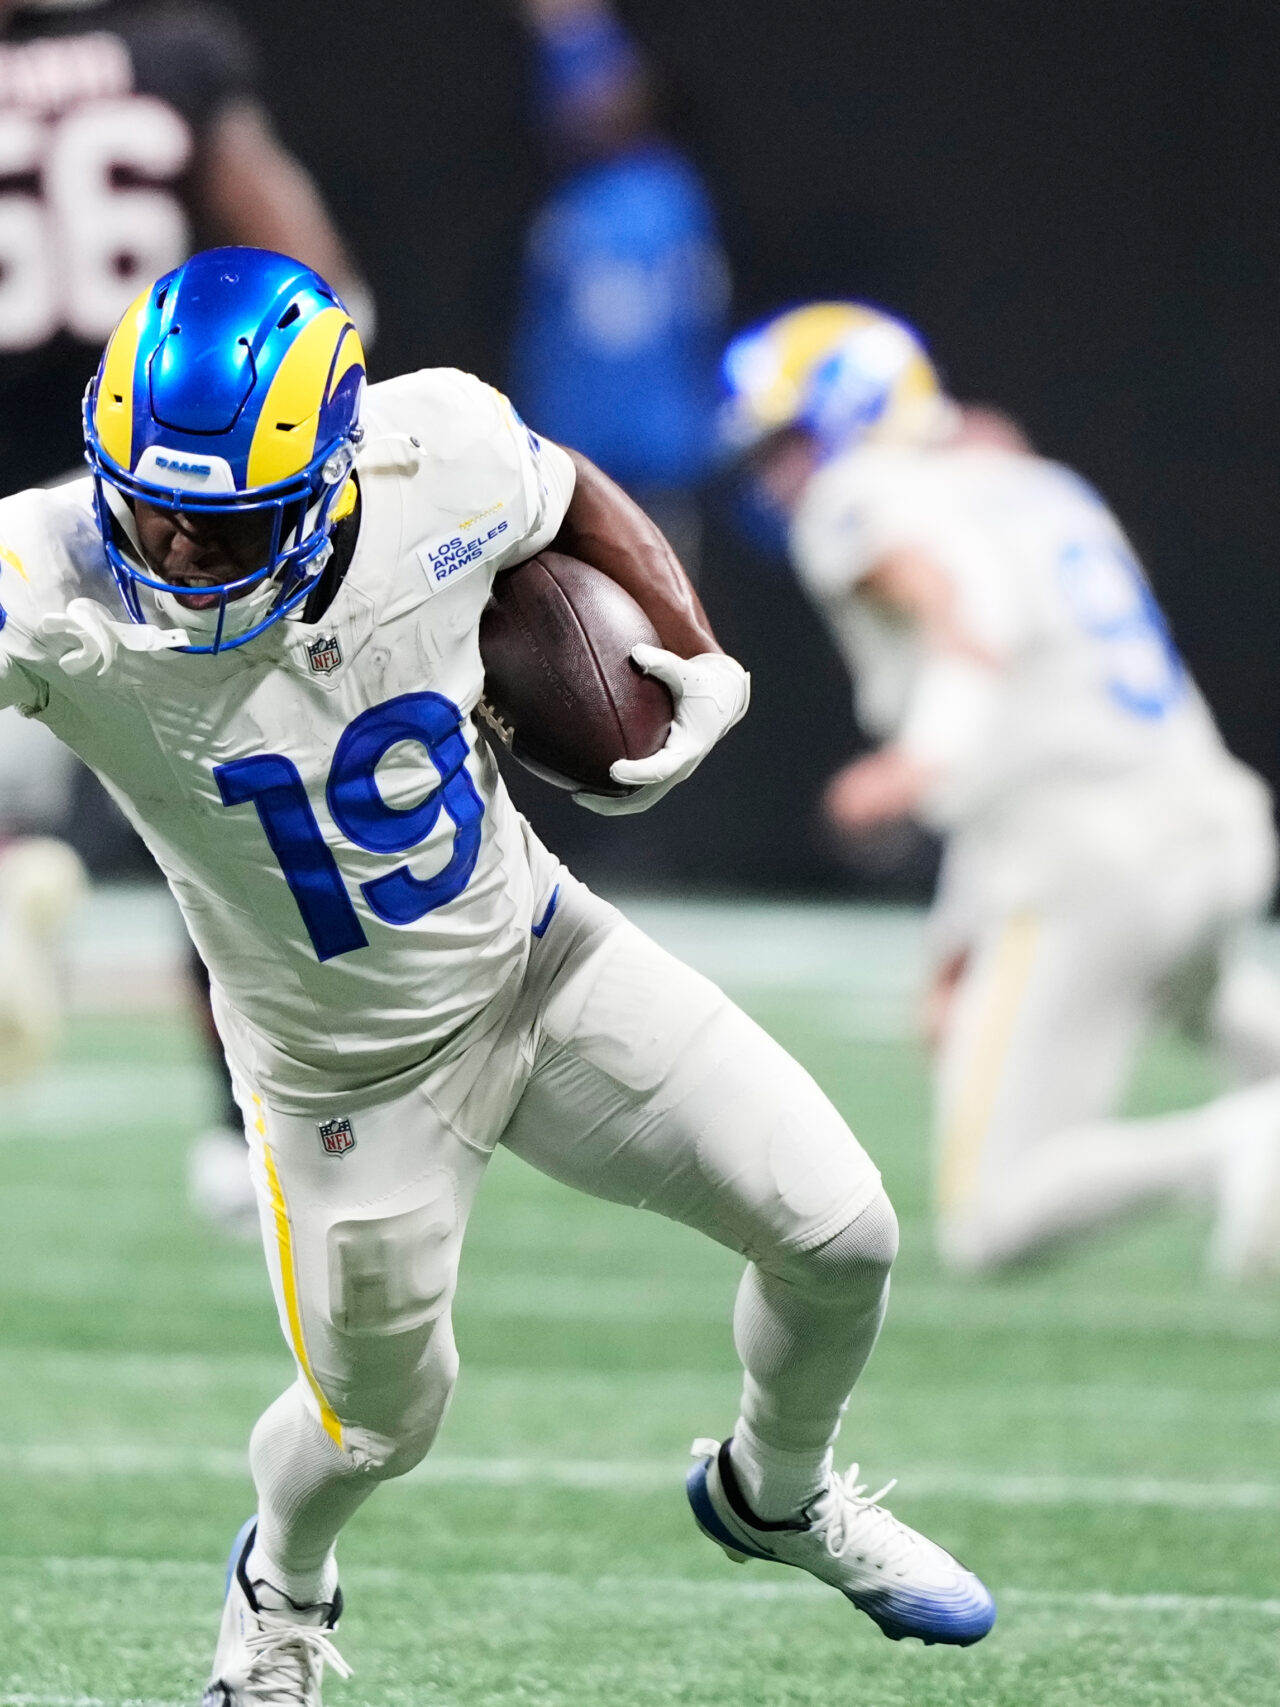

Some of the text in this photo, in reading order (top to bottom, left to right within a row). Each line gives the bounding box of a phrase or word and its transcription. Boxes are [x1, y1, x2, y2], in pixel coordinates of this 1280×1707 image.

[428, 537, 463, 562] LOS
[434, 520, 508, 572] ANGELES
[435, 548, 483, 581] RAMS
[312, 650, 340, 670] NFL
[212, 691, 486, 963] 19
[325, 1132, 352, 1150] NFL
